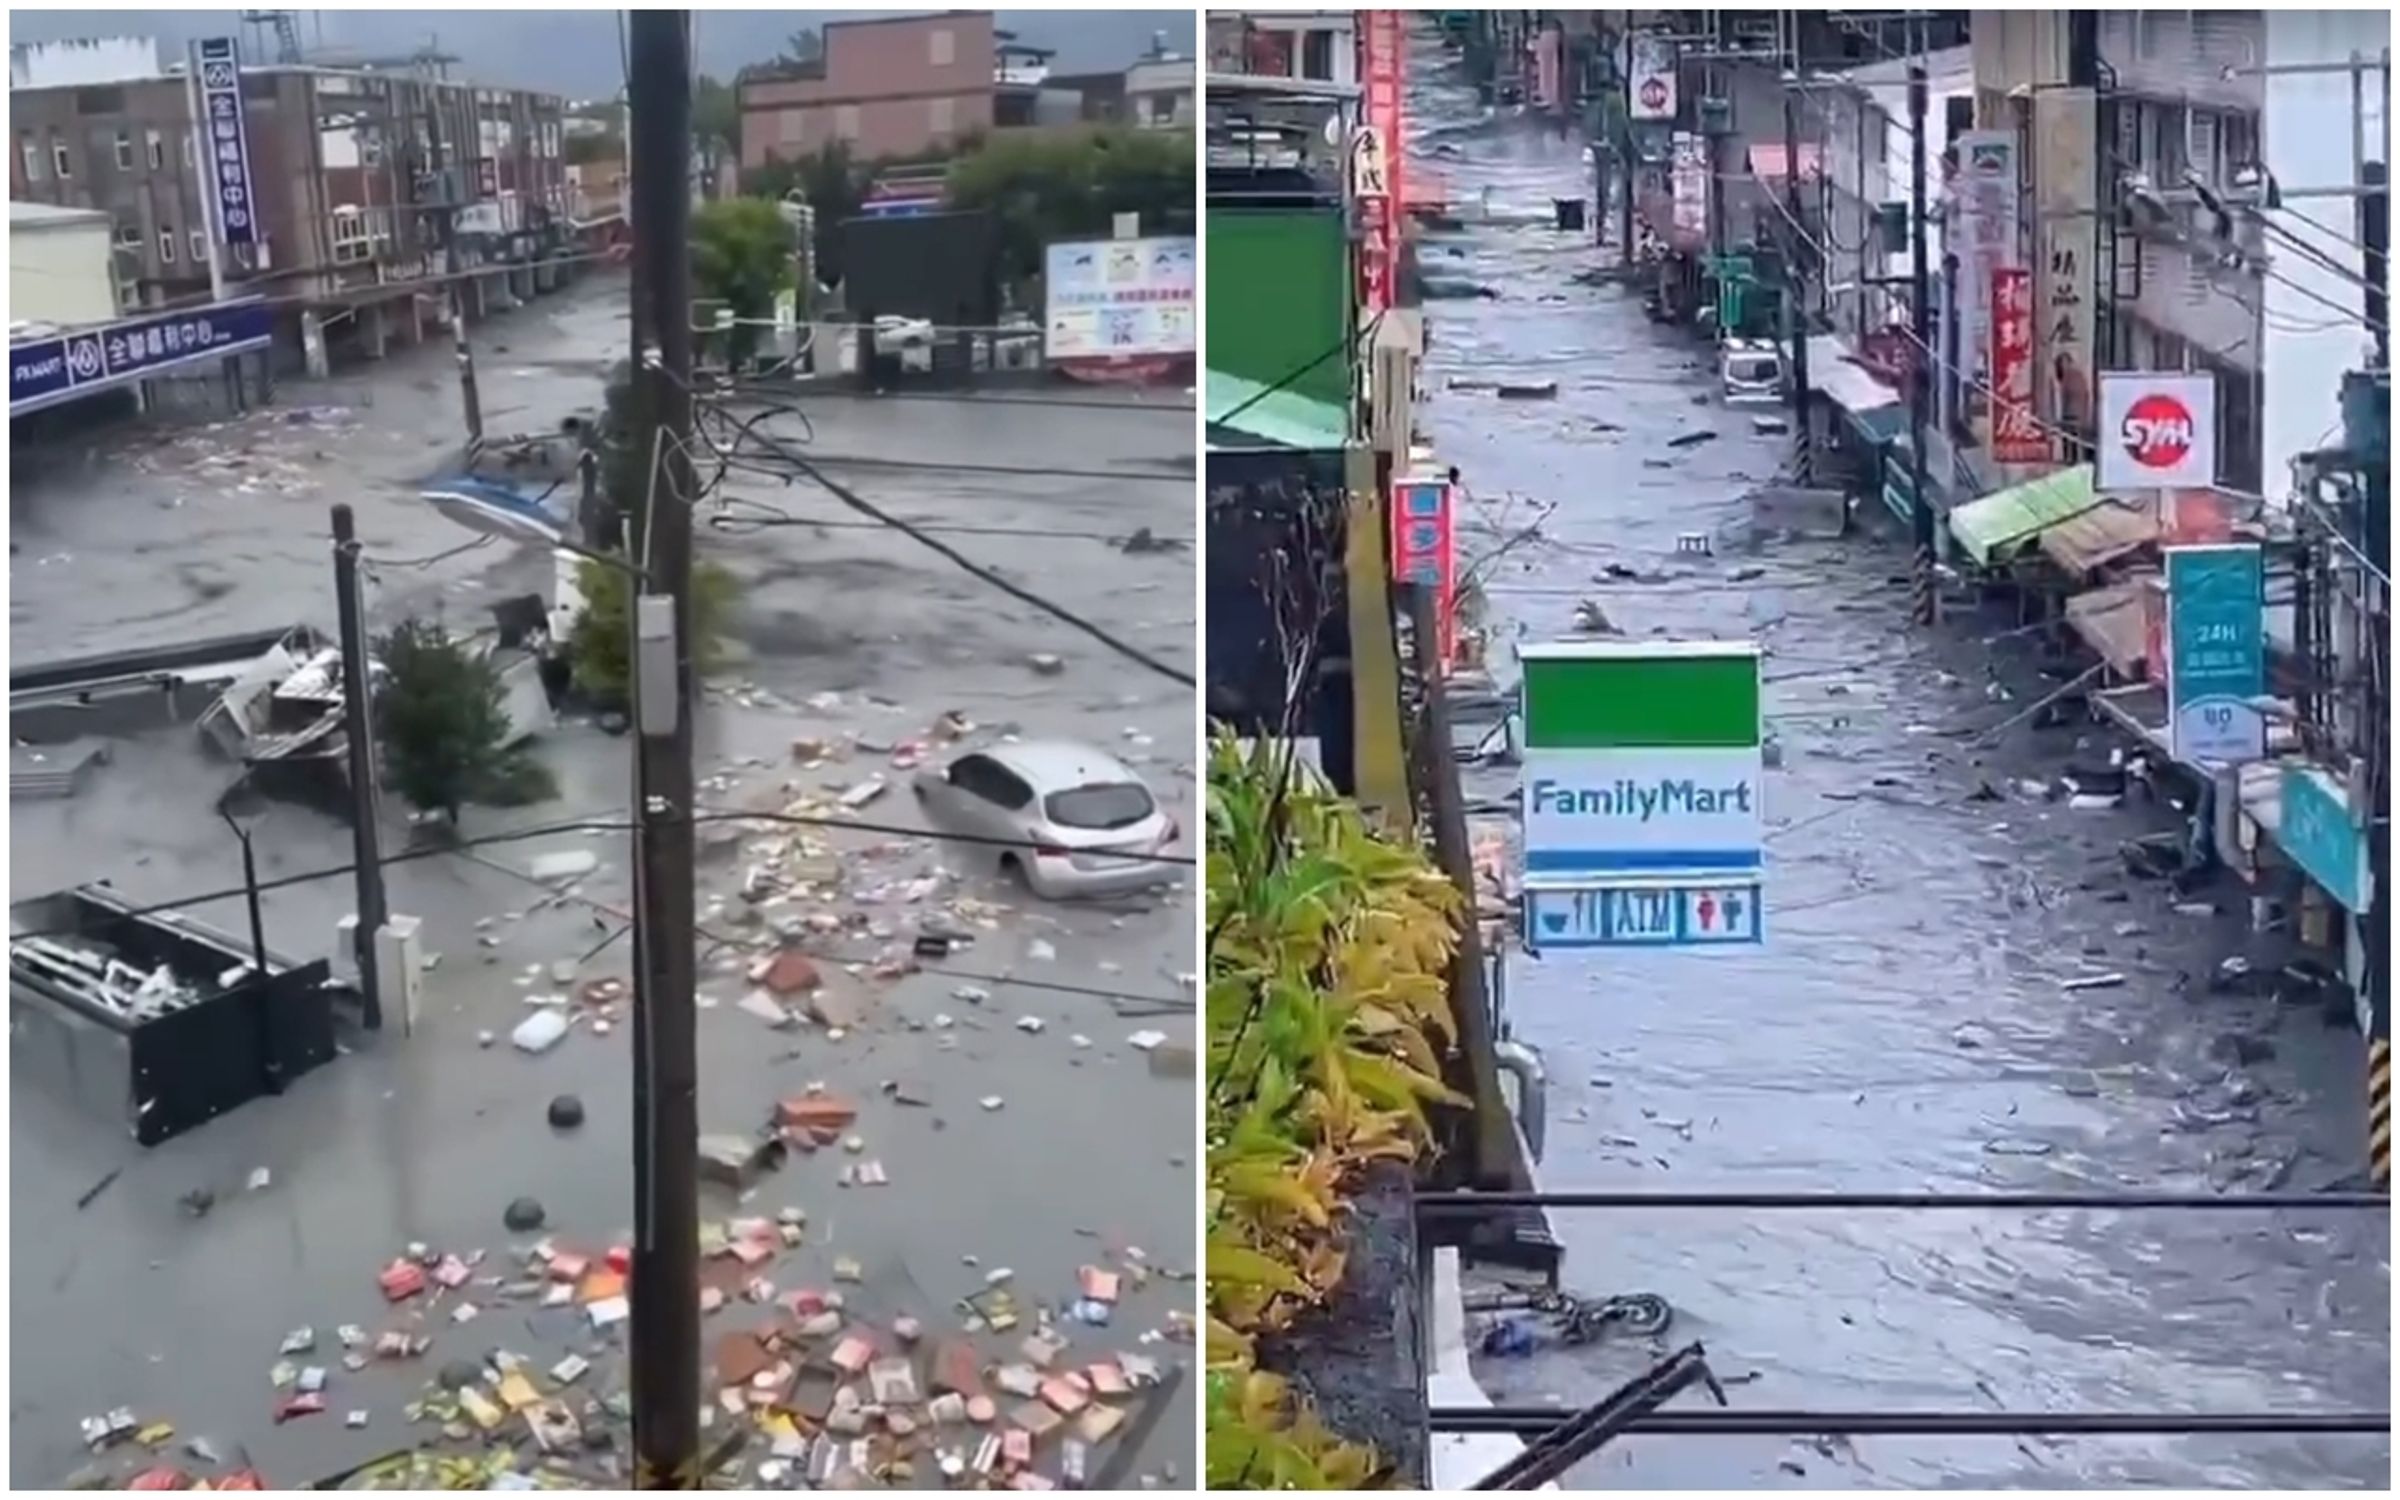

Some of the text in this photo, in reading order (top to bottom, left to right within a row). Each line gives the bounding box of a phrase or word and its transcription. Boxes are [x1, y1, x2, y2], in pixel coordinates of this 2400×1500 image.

[2121, 418, 2192, 454] SYM
[2197, 624, 2236, 642] 24H
[1533, 779, 1751, 822] FamilyMart
[1617, 889, 1670, 932] ATM
